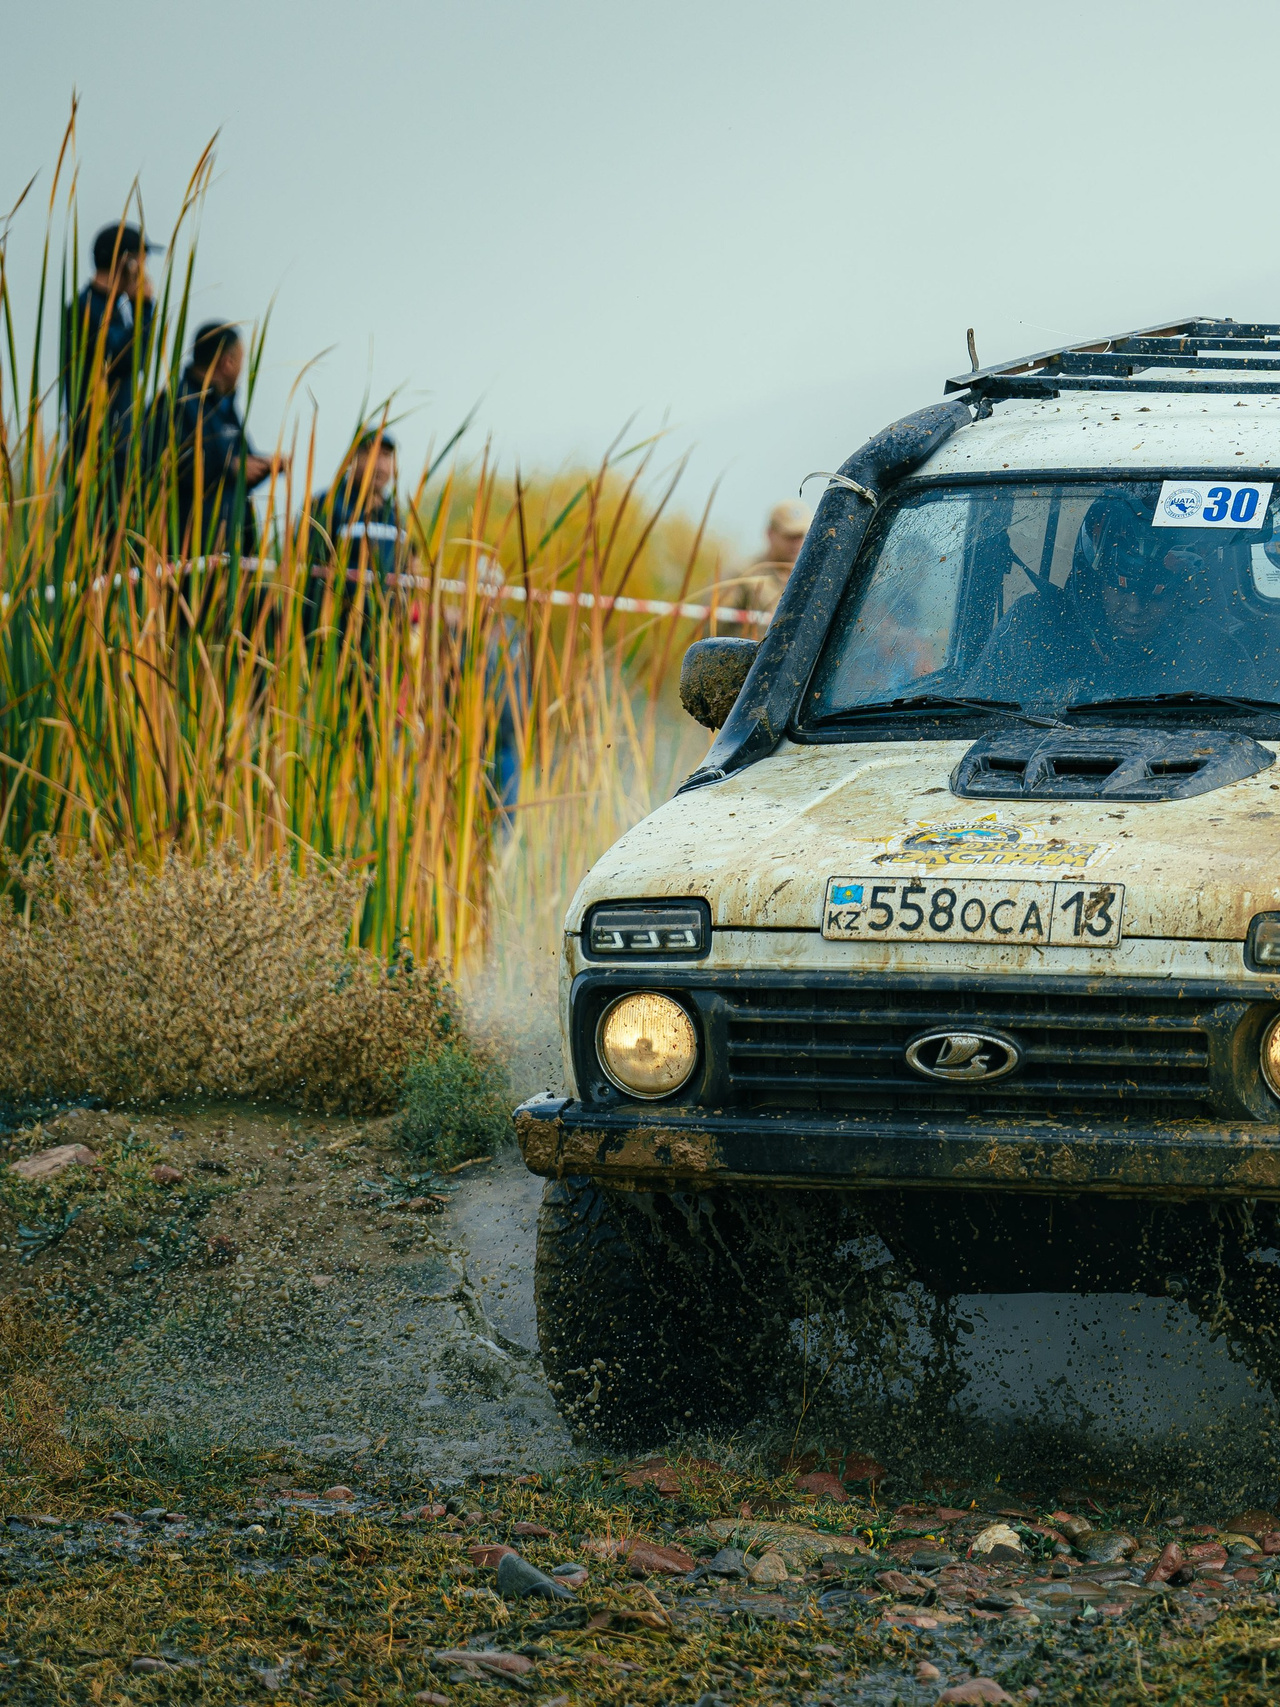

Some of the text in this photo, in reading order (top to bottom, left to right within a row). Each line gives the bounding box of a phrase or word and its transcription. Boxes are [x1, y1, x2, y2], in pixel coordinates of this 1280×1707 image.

[1202, 486, 1259, 522] 30
[889, 850, 1092, 867] ЭКСТРИМ
[826, 911, 860, 931] KZ
[1060, 890, 1117, 937] 13
